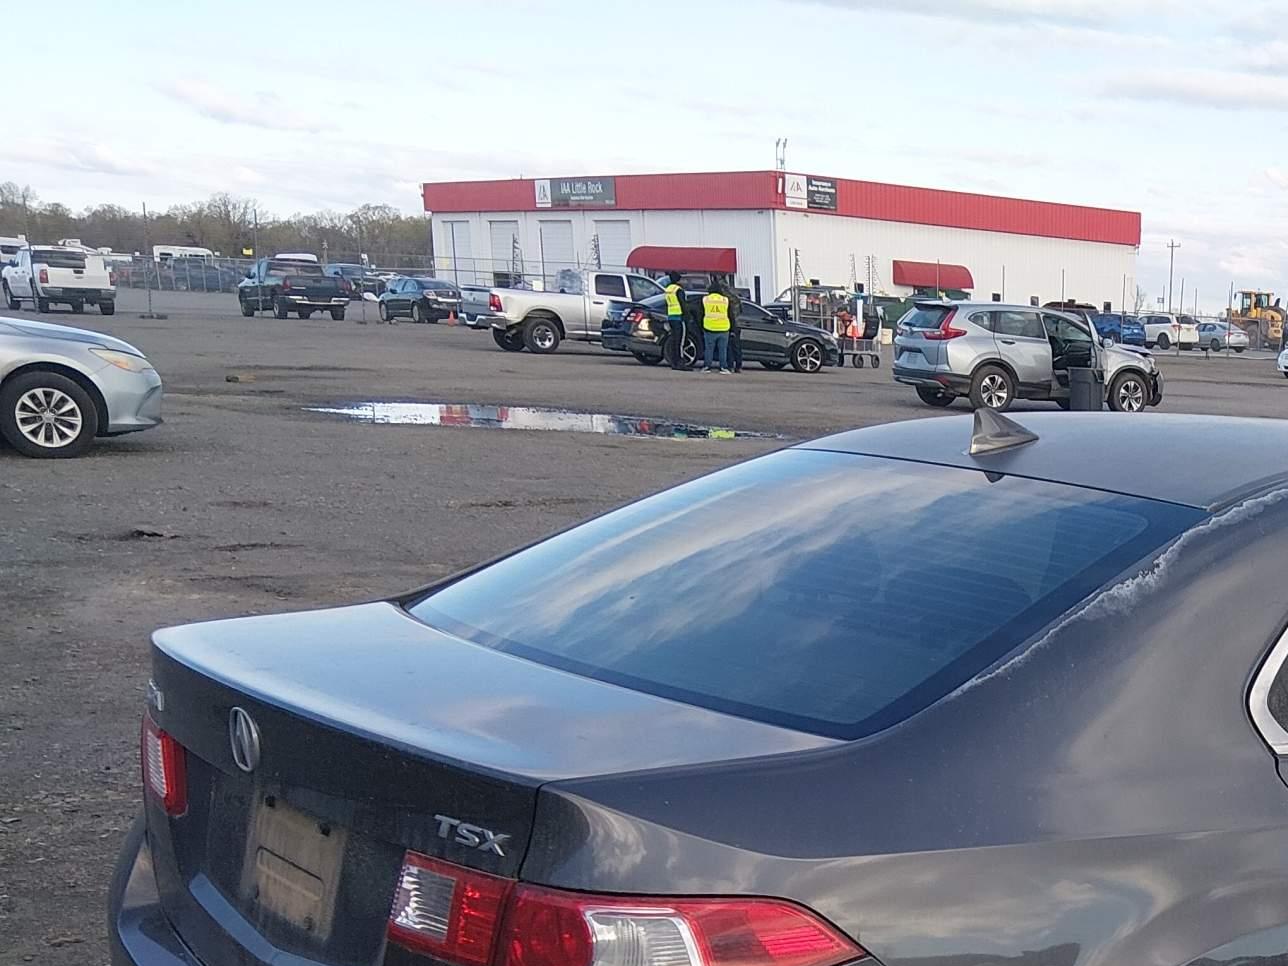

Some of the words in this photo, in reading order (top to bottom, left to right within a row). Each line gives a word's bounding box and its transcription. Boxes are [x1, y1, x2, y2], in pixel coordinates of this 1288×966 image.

[560, 181, 571, 194] IAA
[571, 180, 586, 194] Little
[587, 180, 603, 194] Rock
[433, 814, 513, 857] TSX
